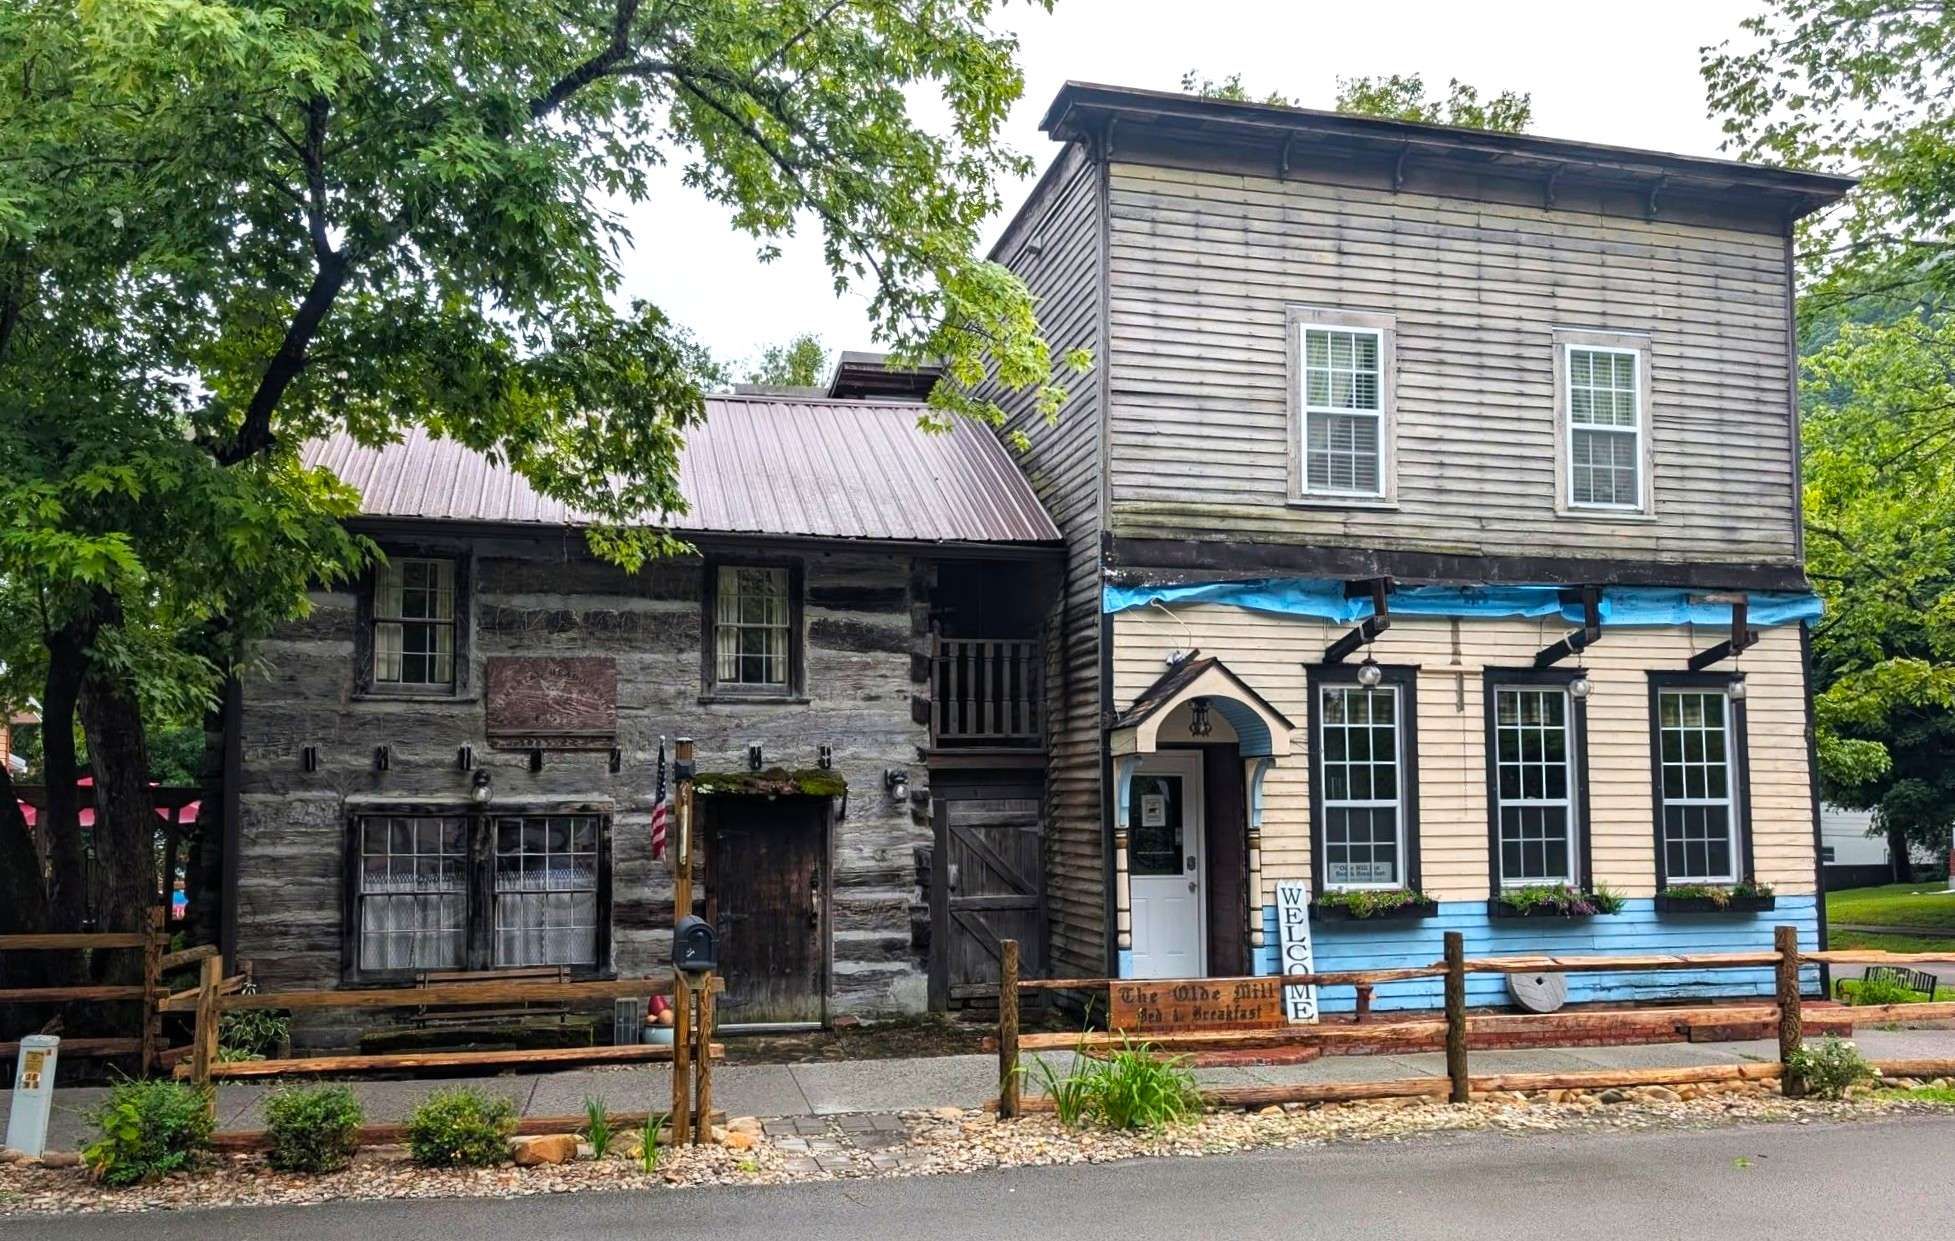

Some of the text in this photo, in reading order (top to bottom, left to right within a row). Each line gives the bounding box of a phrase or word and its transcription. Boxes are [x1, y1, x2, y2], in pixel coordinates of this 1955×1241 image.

[1281, 887, 1314, 1020] WELCOME
[1119, 982, 1274, 1004] The Olde Mill
[1139, 1006, 1163, 1023] Bed
[1192, 1004, 1262, 1022] Breakfast
